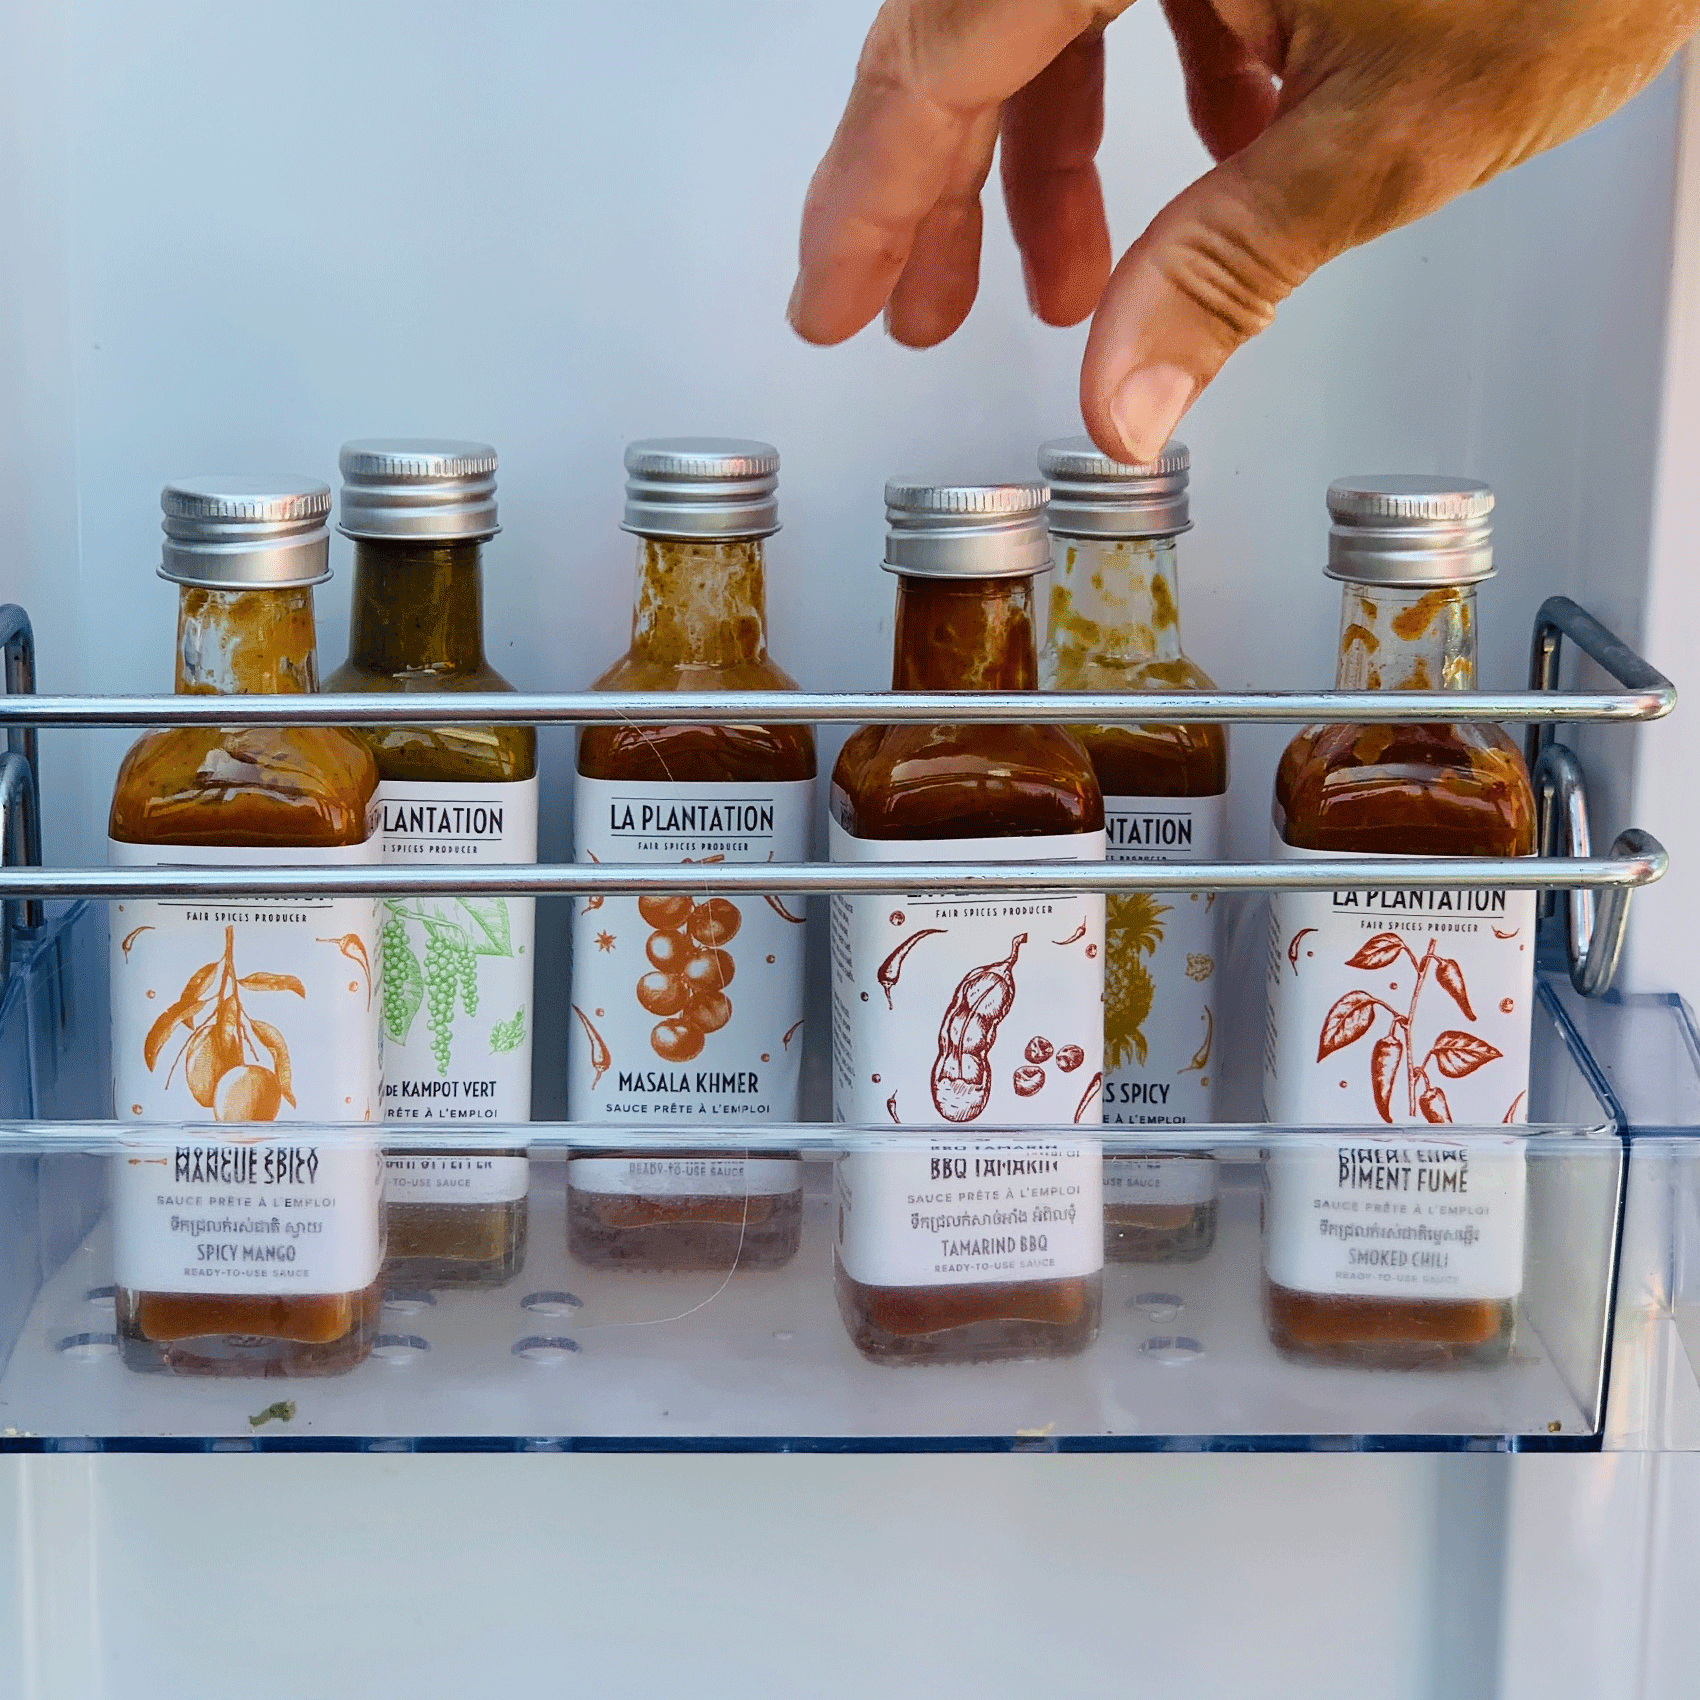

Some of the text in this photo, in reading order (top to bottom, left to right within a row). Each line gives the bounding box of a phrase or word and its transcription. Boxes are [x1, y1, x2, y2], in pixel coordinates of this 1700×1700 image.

[383, 805, 503, 834] LANTATION
[611, 804, 774, 832] LA PLANTATION
[1105, 818, 1192, 845] NTATION
[391, 844, 424, 853] SPICES
[429, 845, 478, 854] PRODUCER
[638, 841, 749, 851] FAIR SPICES PRODUCER
[186, 911, 308, 923] FAIR SPICES PRODUCER
[936, 905, 1053, 918] FAIR SPICES PRODUCER
[1360, 919, 1478, 932] FAIR SPICES PRODUCER
[402, 1080, 459, 1098] KAMPOT
[463, 1081, 497, 1097] VERT
[619, 1071, 759, 1094] MASALA KHMER
[1120, 1082, 1170, 1104] SPICY
[388, 1107, 498, 1118] RÊTE À L'EMPLOI
[606, 1102, 770, 1114] SAUCE PRÊTE À L'EMPLOI
[1129, 1114, 1186, 1124] L'EMPLOI
[436, 1178, 471, 1188] SAUCE
[157, 1195, 203, 1206] SAUCE
[209, 1195, 251, 1207] PRÊTE
[907, 1193, 952, 1204] SAUCE
[959, 1190, 999, 1202] PRÊTE
[1005, 1187, 1014, 1199] À
[1313, 1199, 1358, 1212] SAUCE
[1365, 1201, 1407, 1214] PRÊTE
[941, 1234, 1048, 1257] TAMARIND BBQ
[197, 1244, 296, 1262] SPICY MANGO
[1349, 1248, 1448, 1269] SMOKED CHILI
[1019, 1258, 1055, 1269] SAUCE
[184, 1267, 310, 1278] READY-TO-USE SAUCE
